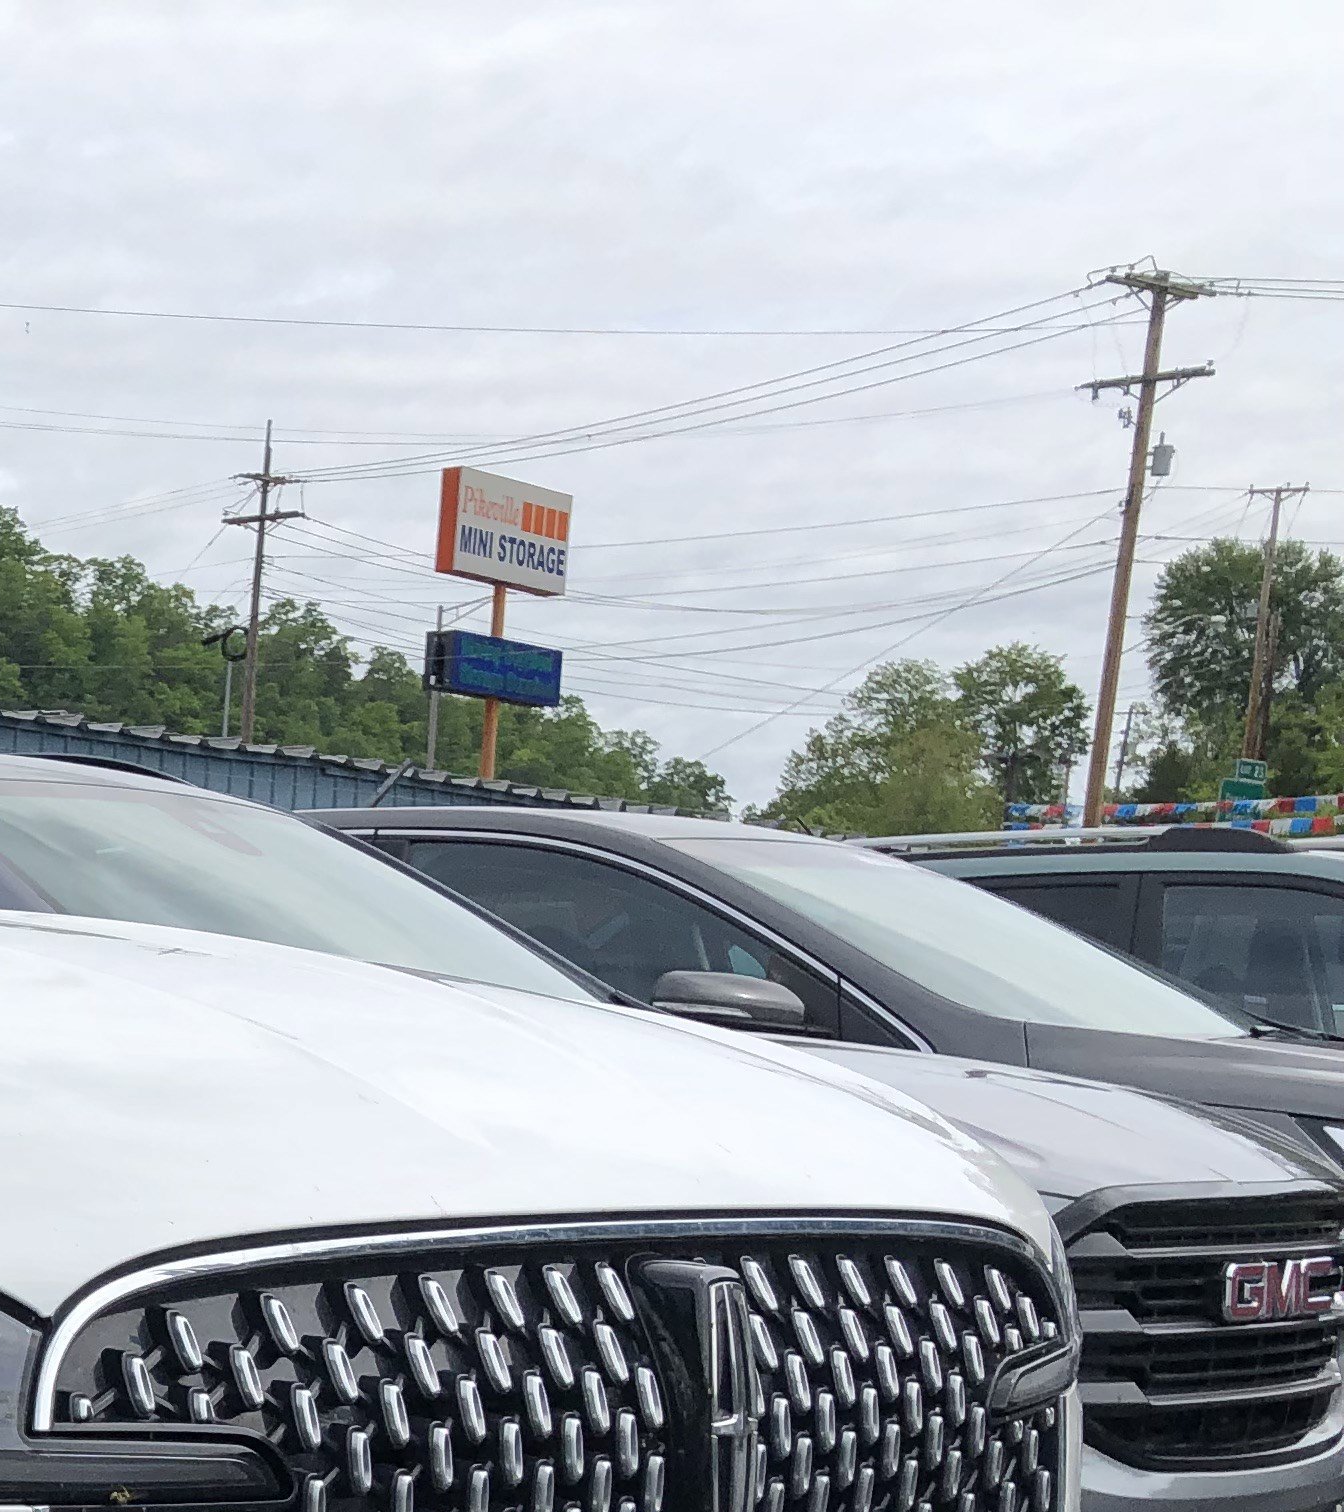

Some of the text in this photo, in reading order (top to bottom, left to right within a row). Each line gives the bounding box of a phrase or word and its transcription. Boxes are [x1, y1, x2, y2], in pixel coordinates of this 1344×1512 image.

[459, 524, 566, 576] MINI STORAGE
[1224, 1256, 1335, 1320] GMC
